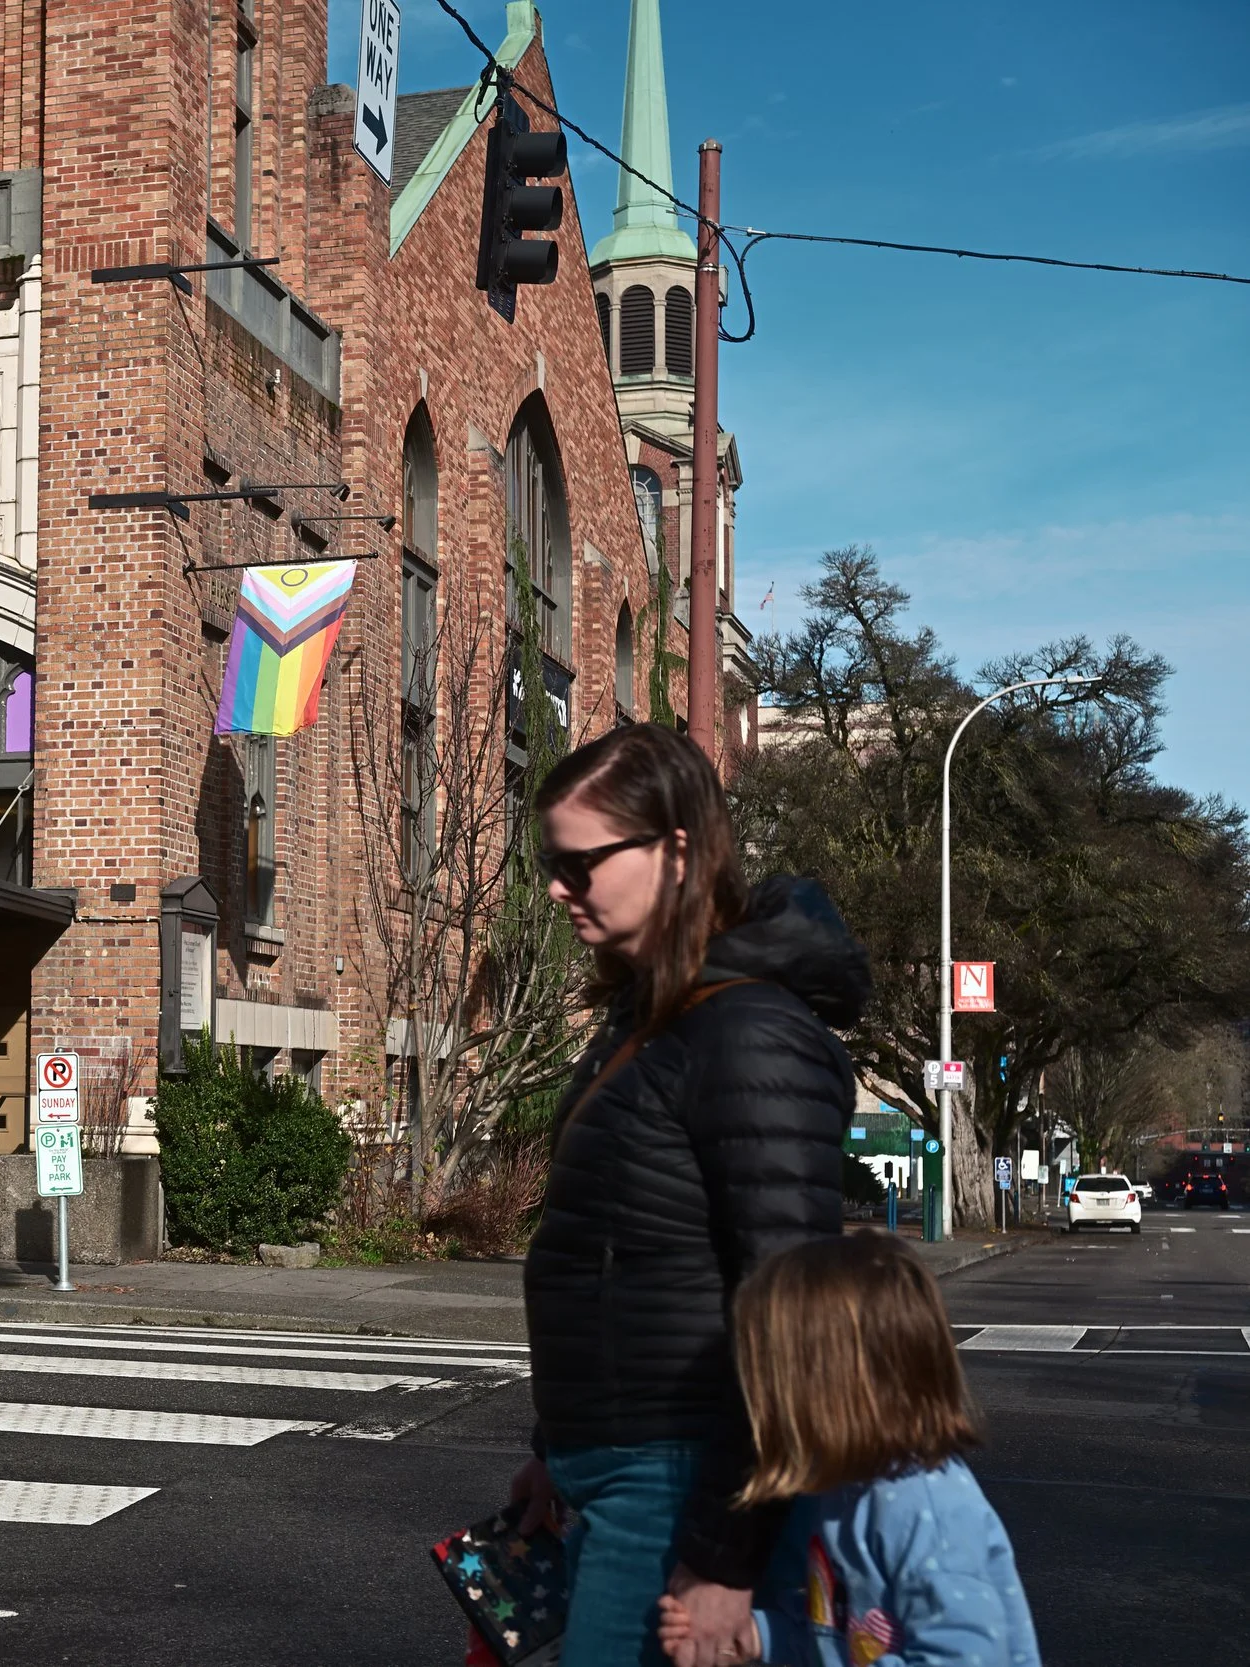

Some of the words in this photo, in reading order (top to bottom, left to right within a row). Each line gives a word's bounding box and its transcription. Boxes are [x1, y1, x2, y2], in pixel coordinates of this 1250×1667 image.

[370, 0, 394, 55] ONE
[366, 36, 393, 100] WAY
[963, 966, 985, 987] N
[930, 1074, 938, 1085] 5
[41, 1097, 76, 1109] SUNDAY
[51, 1155, 67, 1163] PAY
[54, 1164, 66, 1172] TO
[48, 1172, 72, 1181] PARK
